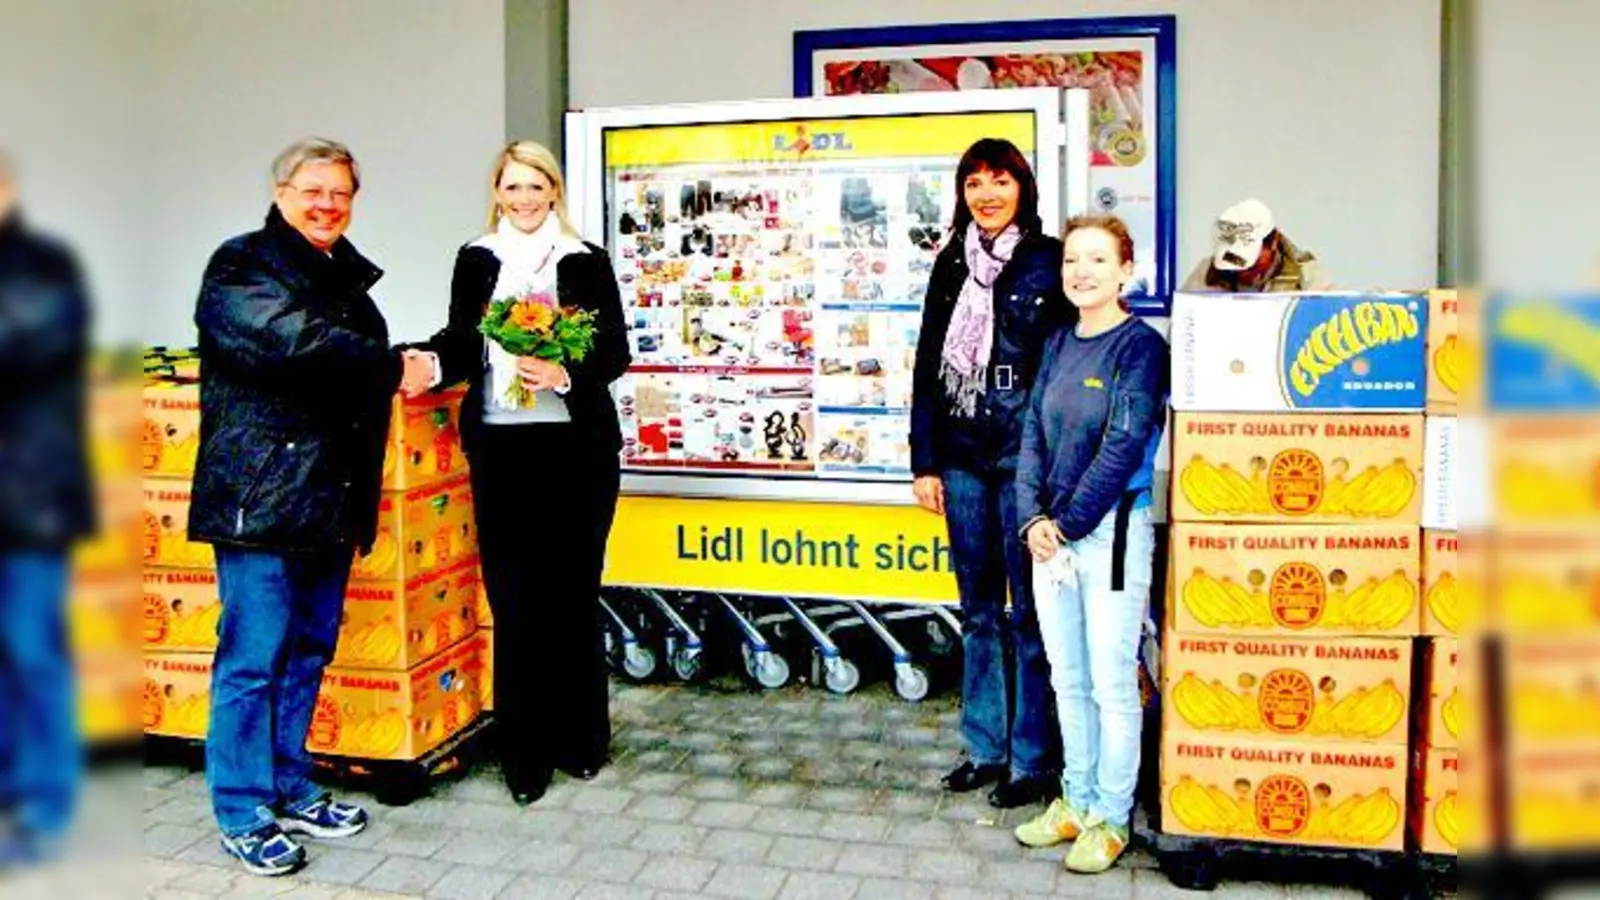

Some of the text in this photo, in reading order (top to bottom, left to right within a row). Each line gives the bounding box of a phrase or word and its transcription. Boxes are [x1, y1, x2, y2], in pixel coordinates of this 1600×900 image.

[1187, 421, 1411, 438] FIRST QUALITY BANANAS
[677, 524, 955, 573] Lidl lohnt sich
[1188, 535, 1411, 551] FIRST QUALITY BANANAS
[167, 573, 216, 585] BANANA
[1179, 640, 1401, 662] FIRST QUALITY BANANAS
[1177, 744, 1397, 770] FIRST QUALITY BANANAS
